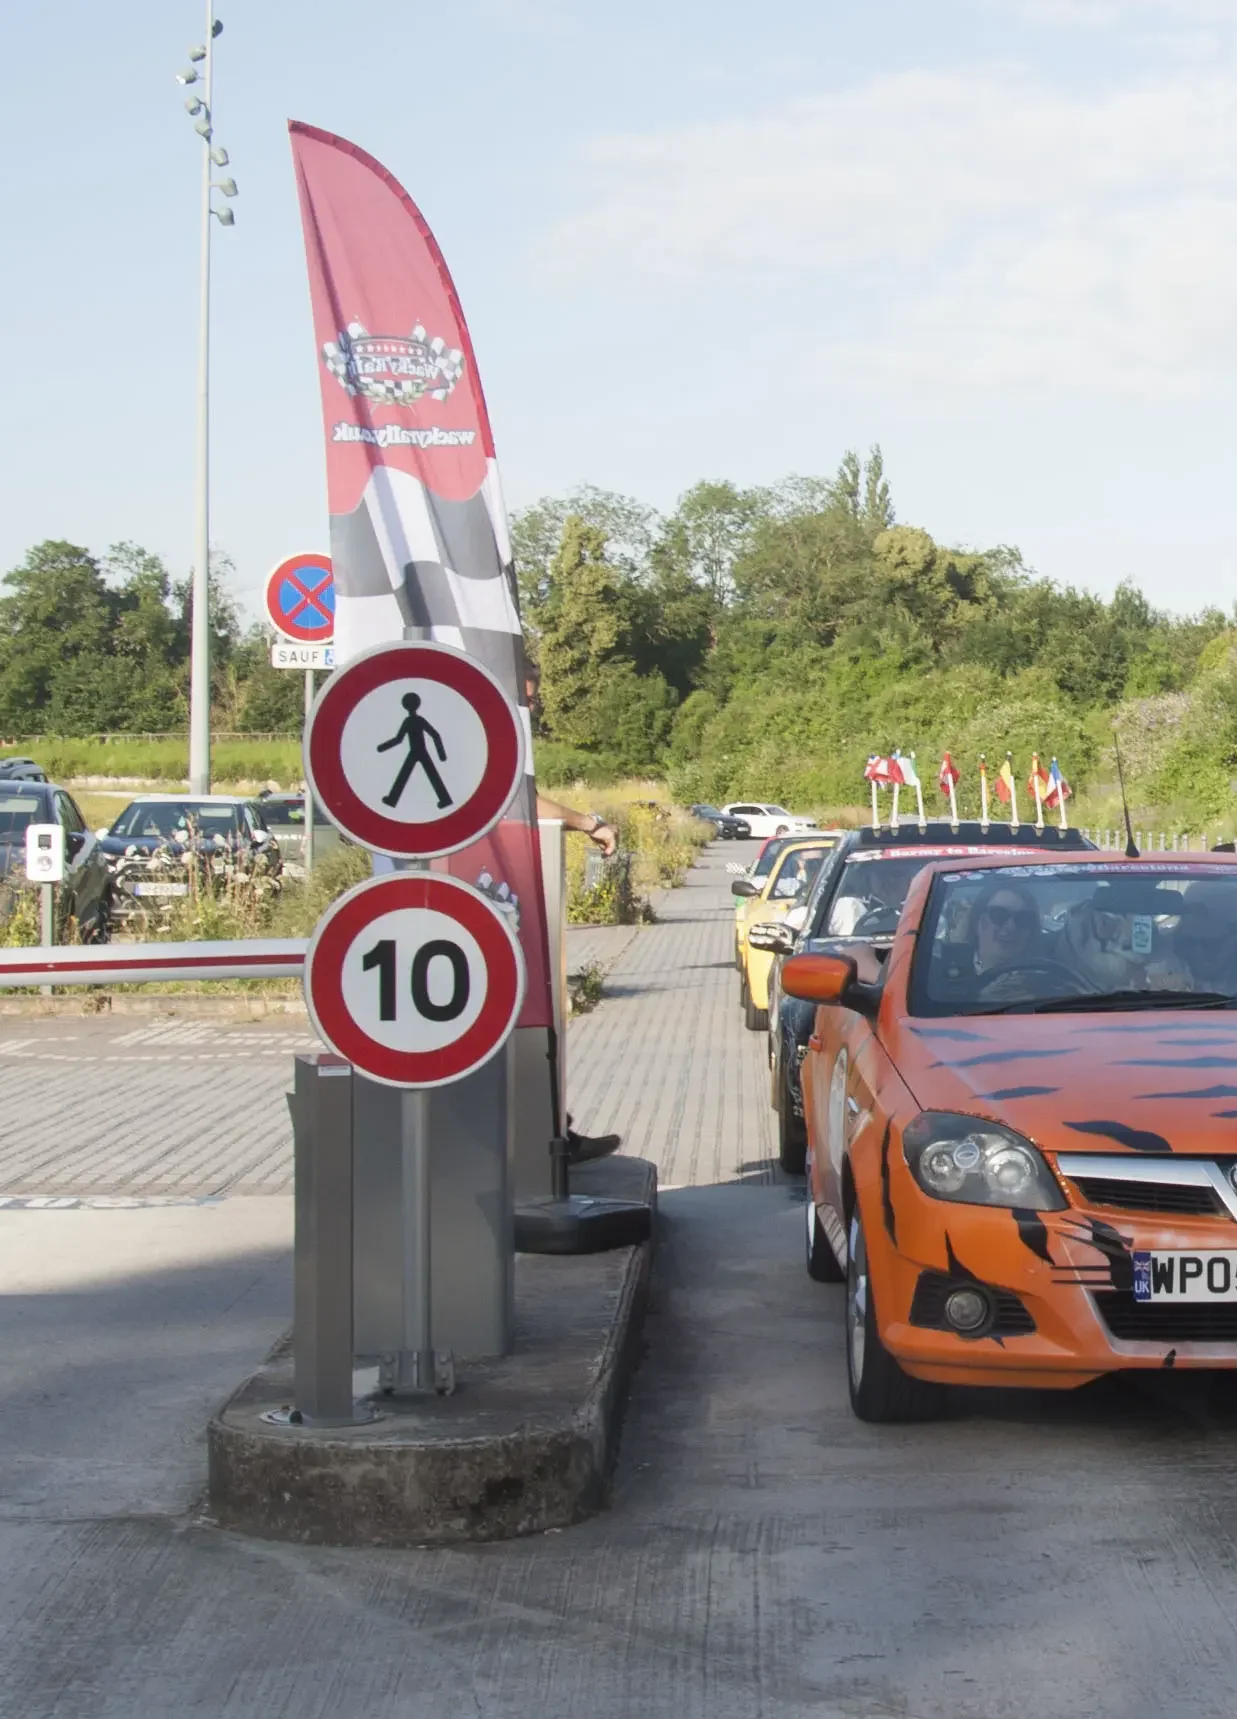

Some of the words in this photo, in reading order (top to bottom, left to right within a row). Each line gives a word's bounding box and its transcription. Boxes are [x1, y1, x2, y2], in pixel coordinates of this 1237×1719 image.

[278, 648, 320, 663] SAUF
[946, 847, 963, 855] to
[362, 939, 471, 1023] 10
[1134, 1280, 1150, 1294] UK
